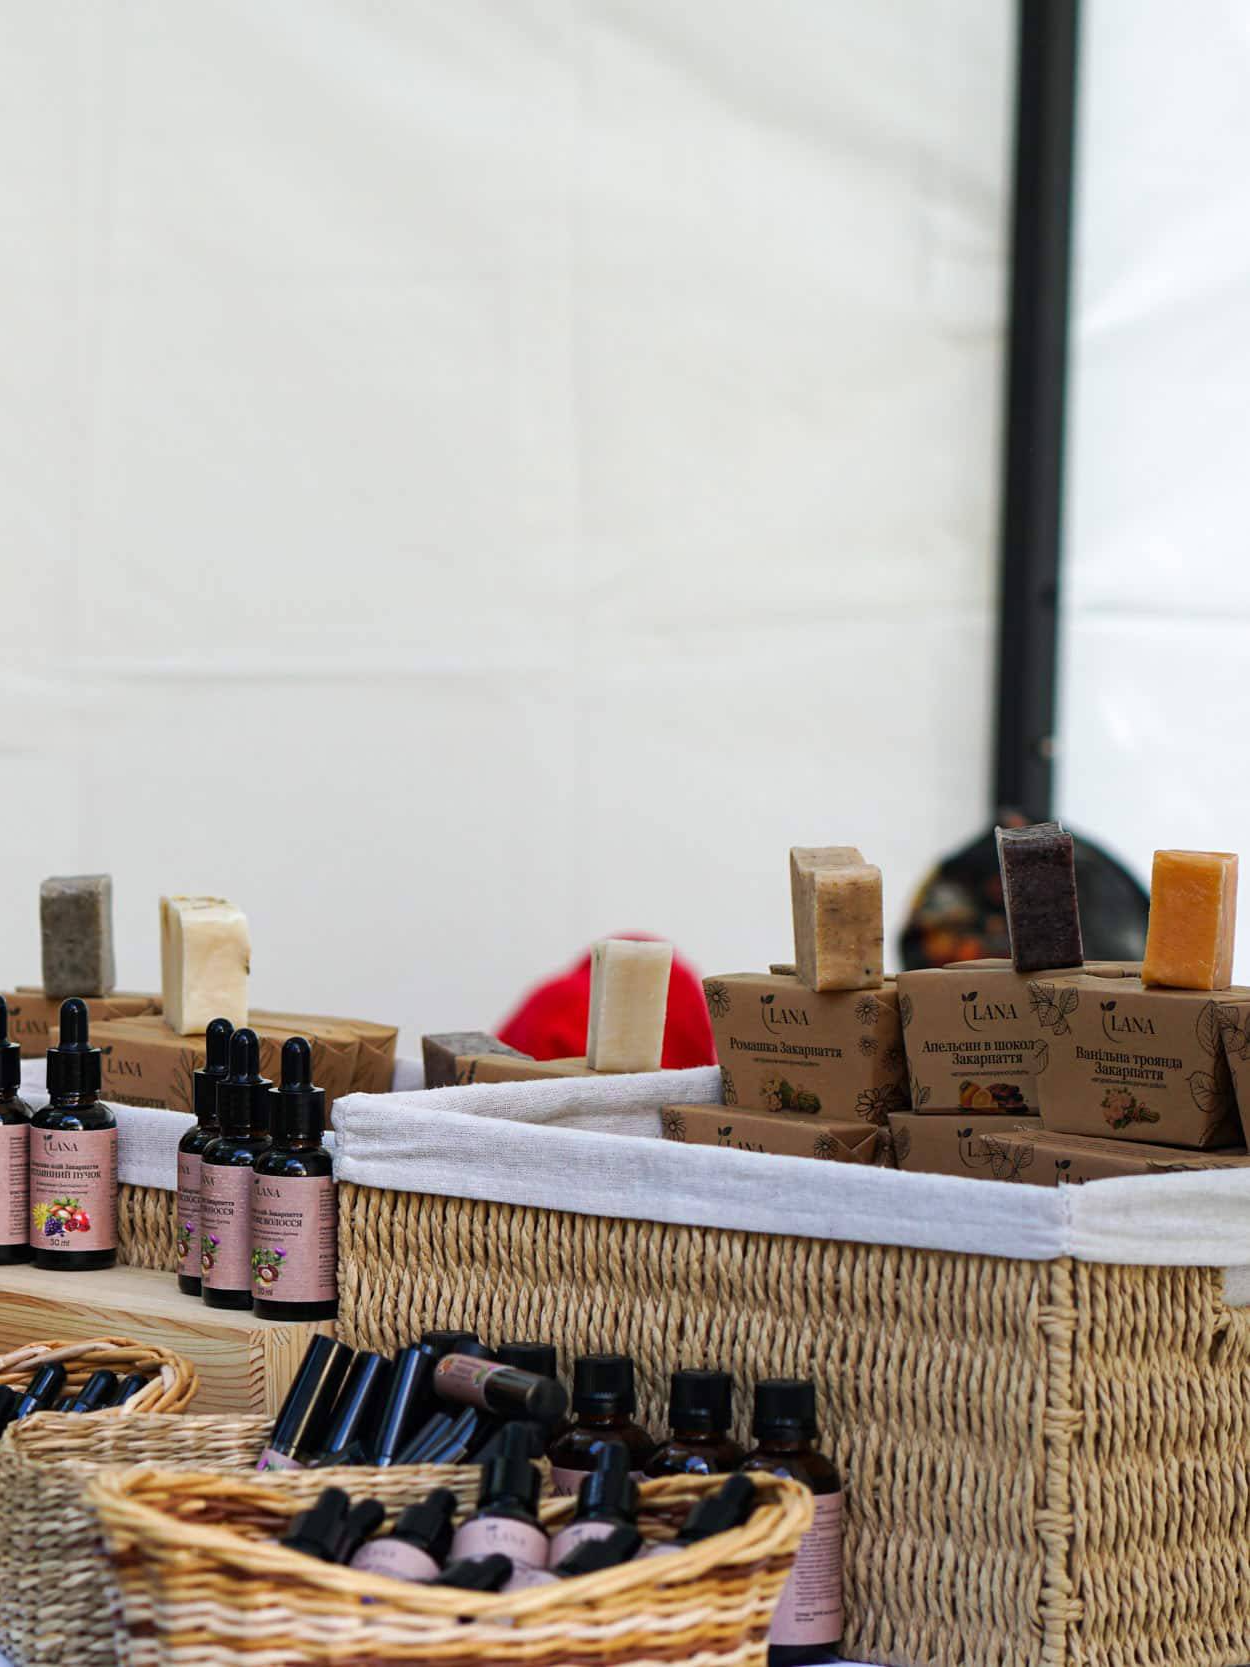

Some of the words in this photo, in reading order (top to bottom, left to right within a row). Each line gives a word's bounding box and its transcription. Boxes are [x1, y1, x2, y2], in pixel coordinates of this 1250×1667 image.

[770, 1007, 810, 1025] LANA
[973, 1003, 1018, 1020] LANA
[1111, 1015, 1157, 1035] LANA
[729, 1037, 778, 1053] Ромашка
[779, 1041, 843, 1059] Закарпаття
[922, 1040, 981, 1053] Апельсин
[984, 1043, 991, 1051] в
[951, 1053, 1023, 1068] Закарпаття
[1075, 1046, 1130, 1064] Ванільна
[1132, 1054, 1183, 1072] троянда
[107, 1058, 143, 1079] LANA
[1094, 1061, 1164, 1081] Закарпаття
[49, 1141, 79, 1152] LANA
[73, 1170, 102, 1180] ПУЧОК
